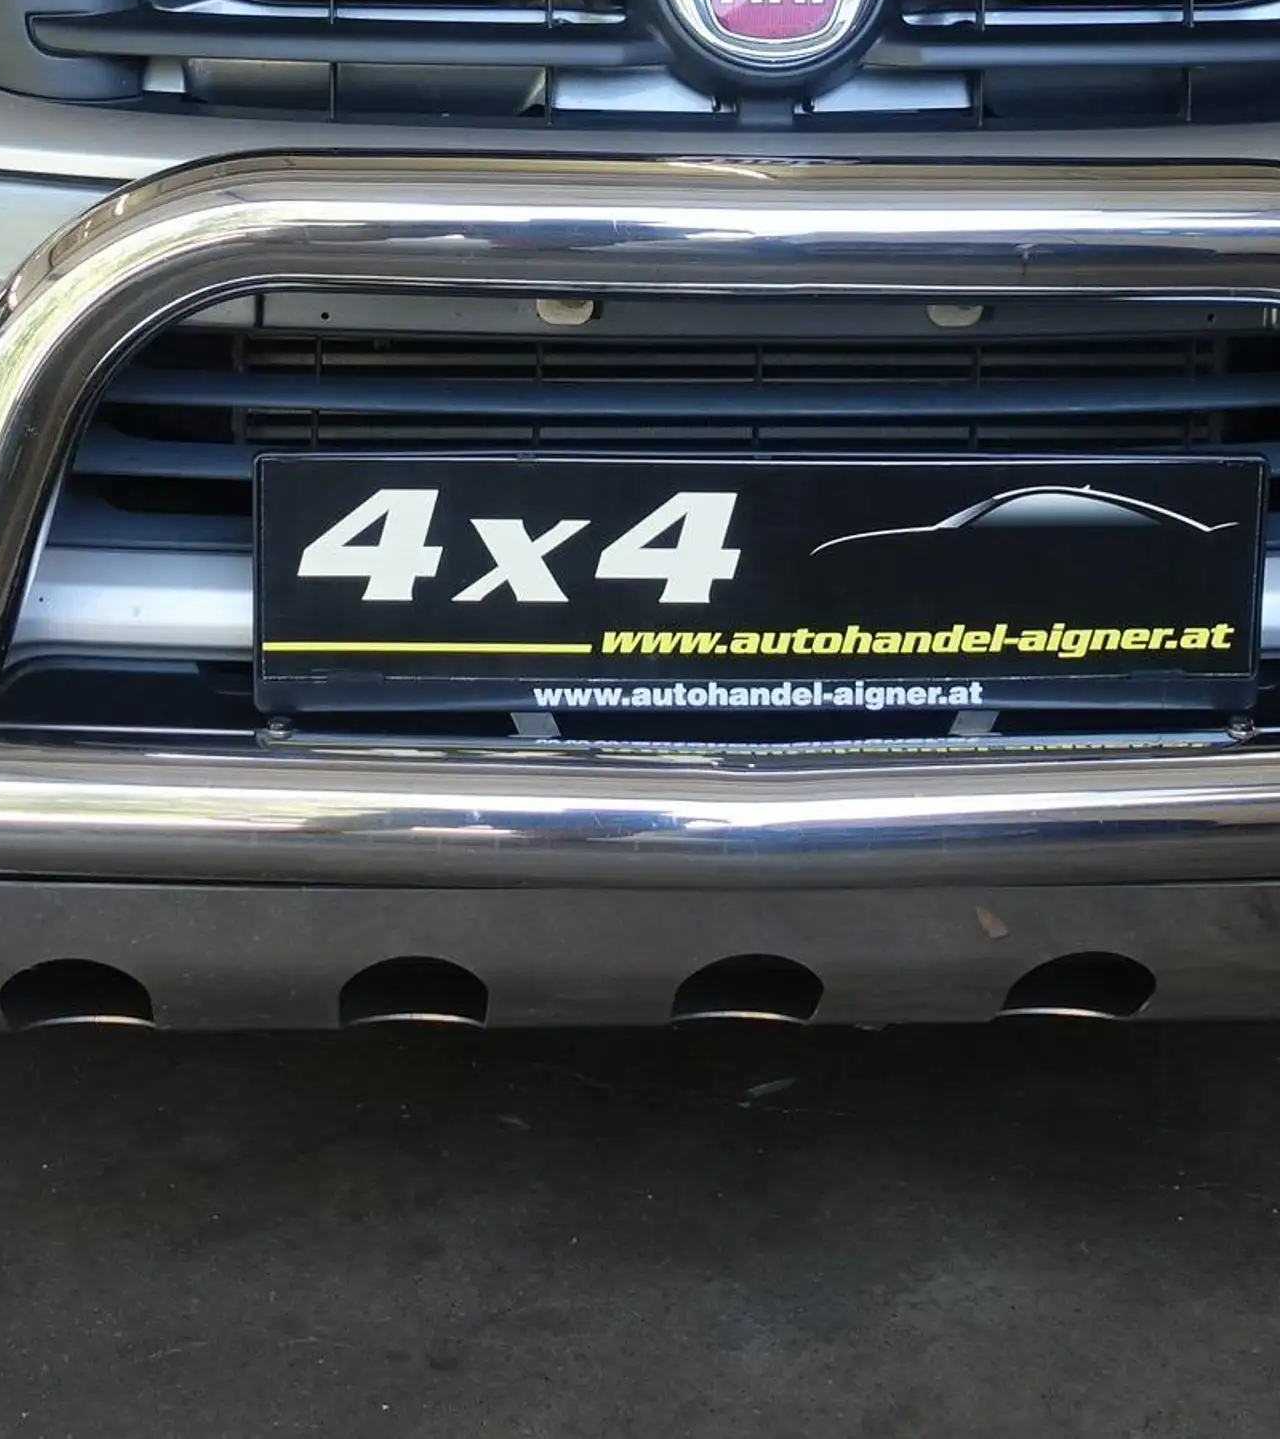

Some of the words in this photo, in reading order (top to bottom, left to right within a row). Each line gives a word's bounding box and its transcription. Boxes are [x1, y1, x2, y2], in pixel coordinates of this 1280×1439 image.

[296, 488, 742, 603] 4x4
[600, 623, 1234, 659] www.autohandel-aigner.at
[533, 680, 984, 711] www.autohandel-aigner.at
